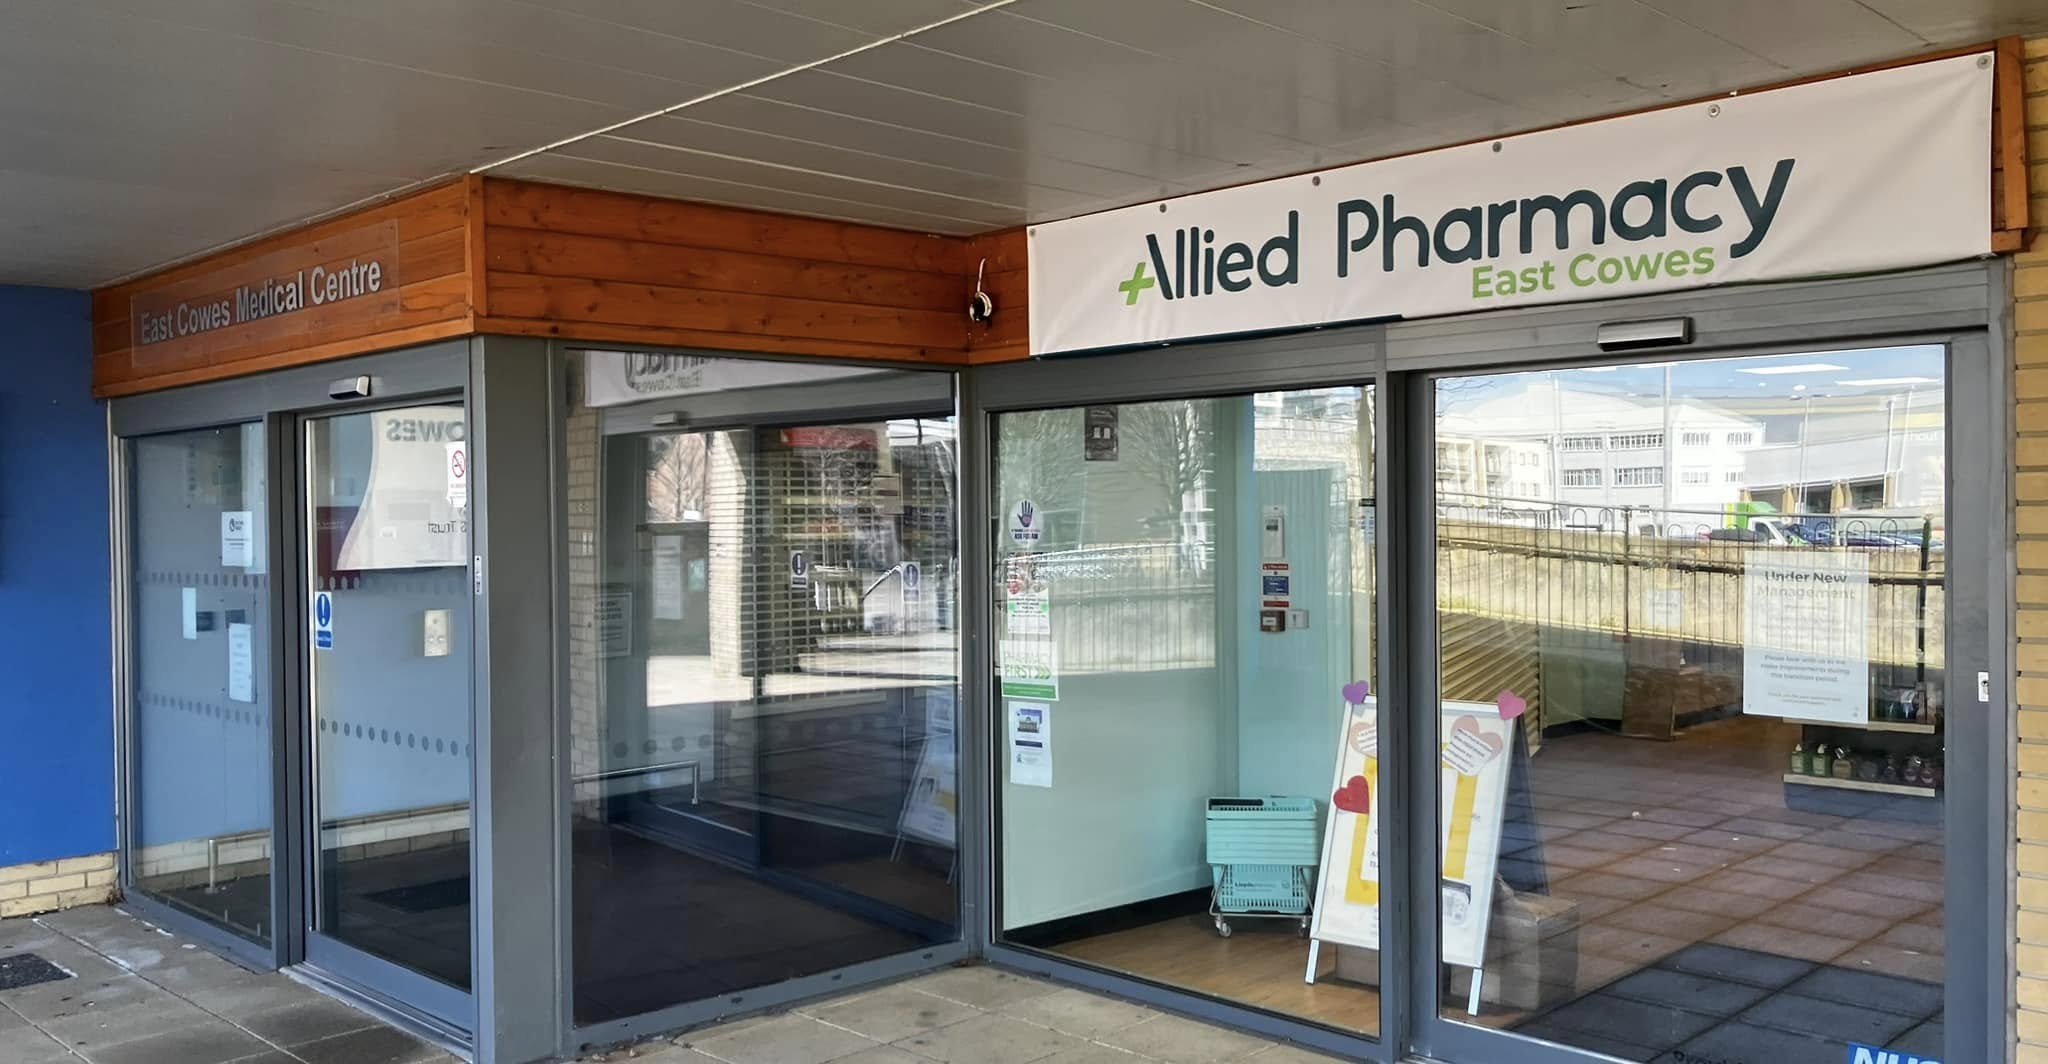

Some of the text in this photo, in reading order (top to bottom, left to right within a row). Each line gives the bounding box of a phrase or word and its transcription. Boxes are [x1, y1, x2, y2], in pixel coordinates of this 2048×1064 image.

[1145, 157, 1796, 302] Allied Pharmacy
[1471, 243, 1715, 300] East Cowes
[141, 257, 382, 345] East Cowes Medical Centre
[1757, 584, 1856, 600] Management
[1764, 570, 1847, 583] Under New
